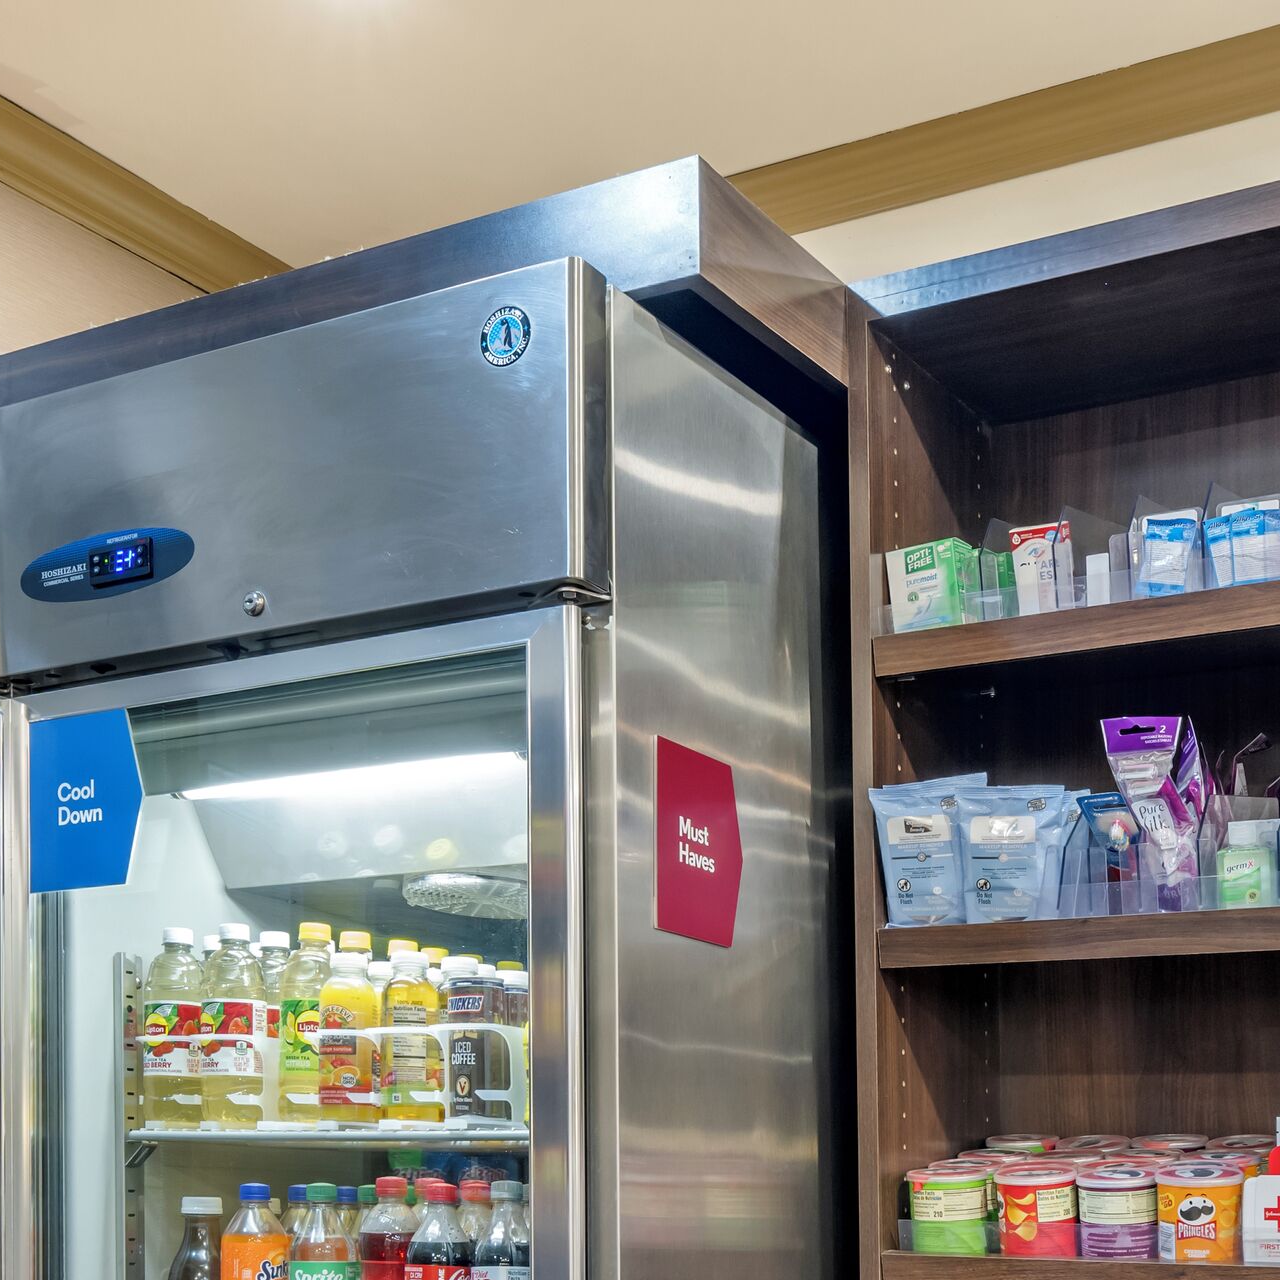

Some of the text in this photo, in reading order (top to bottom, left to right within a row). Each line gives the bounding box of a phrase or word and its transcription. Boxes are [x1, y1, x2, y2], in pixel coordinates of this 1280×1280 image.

[907, 548, 932, 564] OPTI-
[908, 556, 932, 572] FREE
[41, 563, 86, 579] HOSHIZAKI
[1160, 725, 1166, 733] 2
[57, 779, 94, 802] Cool
[58, 806, 102, 826] Down
[1139, 801, 1165, 819] Pure
[679, 816, 709, 846] Must
[679, 842, 715, 873] Haves
[299, 1024, 320, 1034] Lipto
[455, 1042, 471, 1052] ICED
[452, 1053, 475, 1065] COFFEE
[1178, 1223, 1215, 1240] PRINGLES
[438, 1268, 445, 1278] ME
